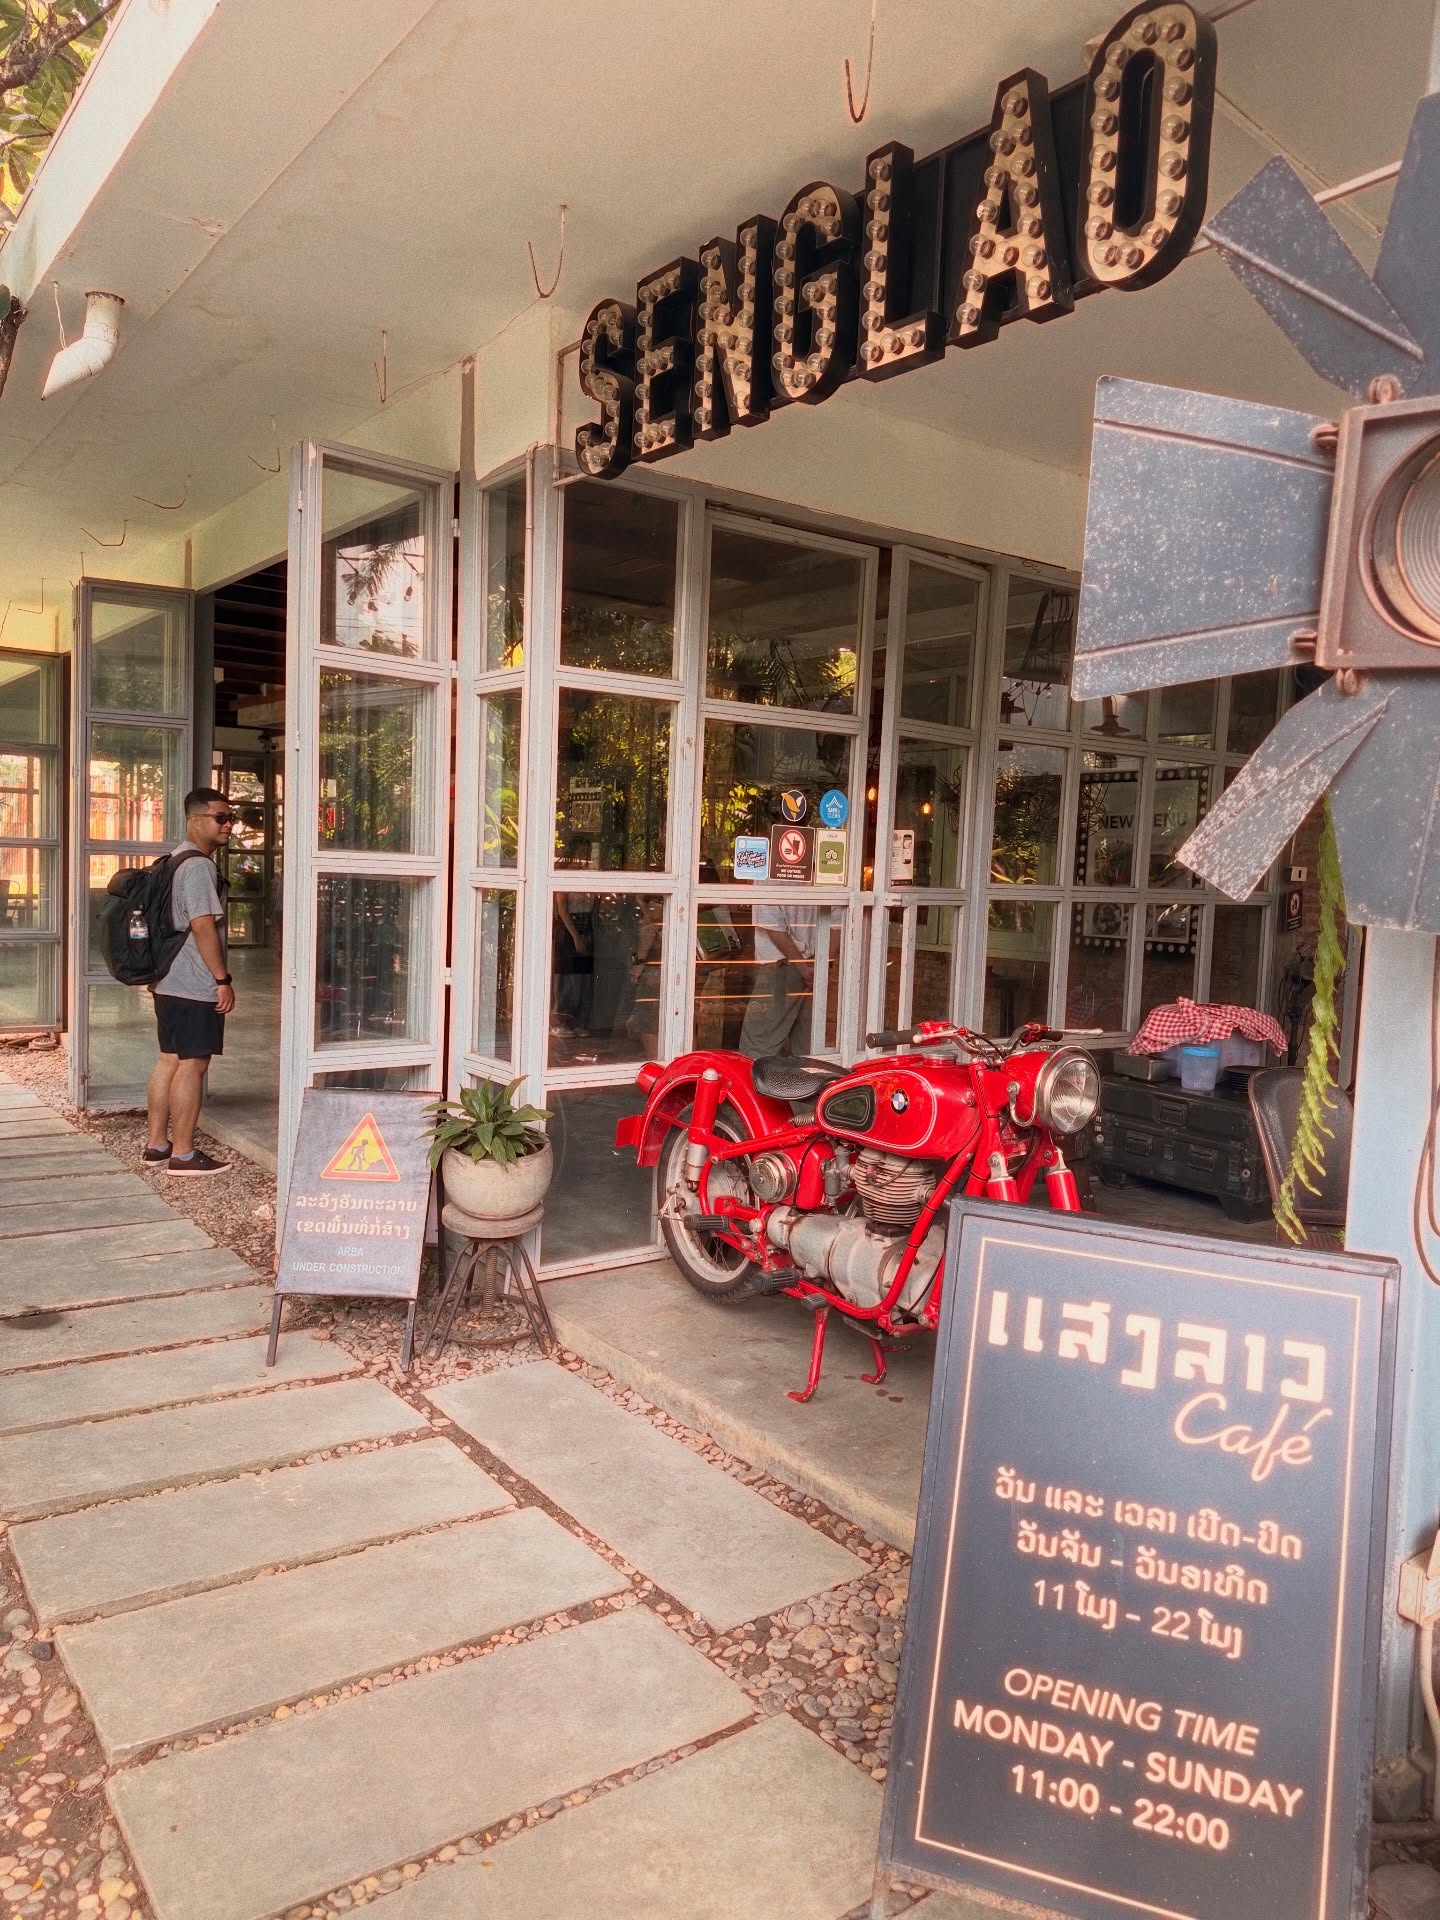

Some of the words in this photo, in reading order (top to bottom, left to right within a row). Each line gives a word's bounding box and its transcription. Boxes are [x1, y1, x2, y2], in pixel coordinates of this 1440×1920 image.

[293, 1262, 326, 1273] UNDER
[329, 1264, 404, 1275] CONSTRUCTION
[337, 1247, 364, 1257] AREA
[988, 1290, 1326, 1402] ແສງລາວ
[1174, 1392, 1333, 1482] Café
[995, 1466, 1036, 1503] ວັນ
[1045, 1486, 1104, 1517] ແລະ
[1115, 1500, 1176, 1534] ເວລາ
[1017, 1519, 1101, 1567] ວັນຈັນ
[1034, 1580, 1064, 1610] 11
[1075, 1580, 1117, 1630] ໂມງ
[1151, 1606, 1191, 1641] 22
[1198, 1607, 1243, 1660] ໂມງ
[1004, 1668, 1163, 1732] OPENING
[1174, 1708, 1260, 1756] TIME
[953, 1699, 1114, 1768] MONDAY
[1145, 1752, 1303, 1818] SUNDAY
[1011, 1764, 1100, 1815] 11:00
[1132, 1798, 1231, 1851] 22:00
